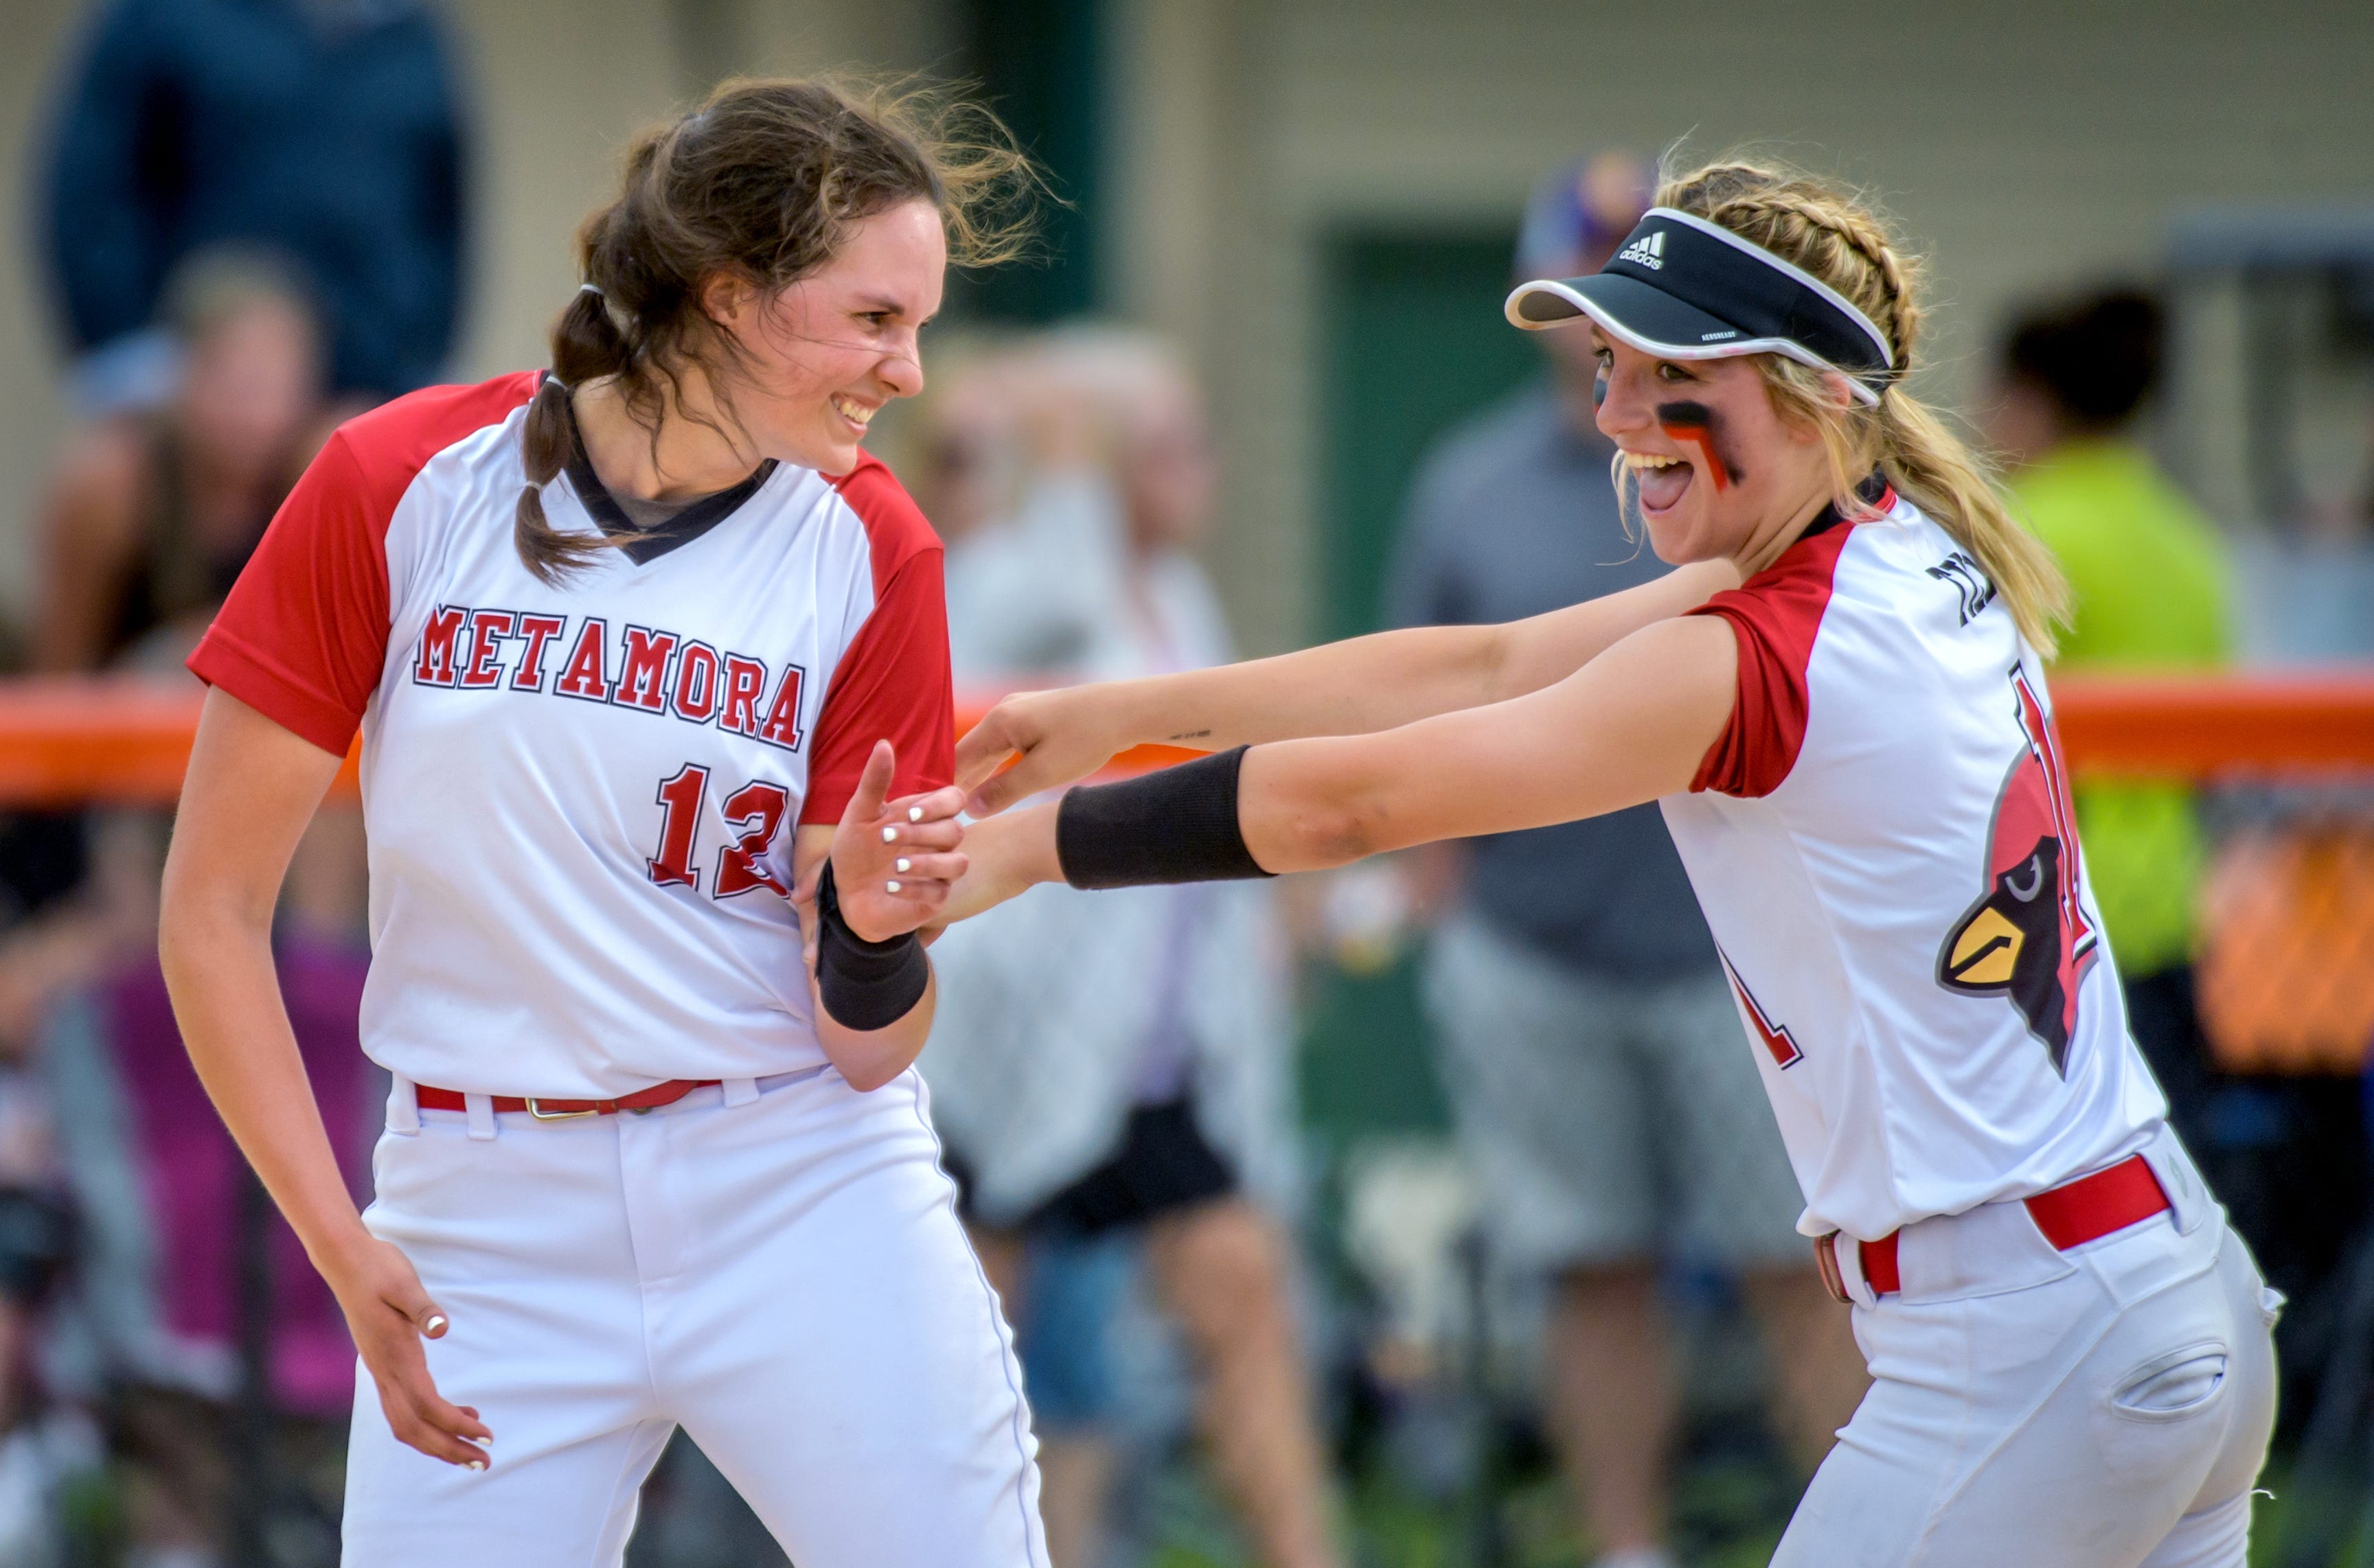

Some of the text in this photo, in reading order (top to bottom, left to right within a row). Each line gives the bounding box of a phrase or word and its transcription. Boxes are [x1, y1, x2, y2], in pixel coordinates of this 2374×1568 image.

[1619, 249, 1662, 270] adidas
[413, 604, 806, 753] METAMORA
[646, 761, 791, 901] 12
